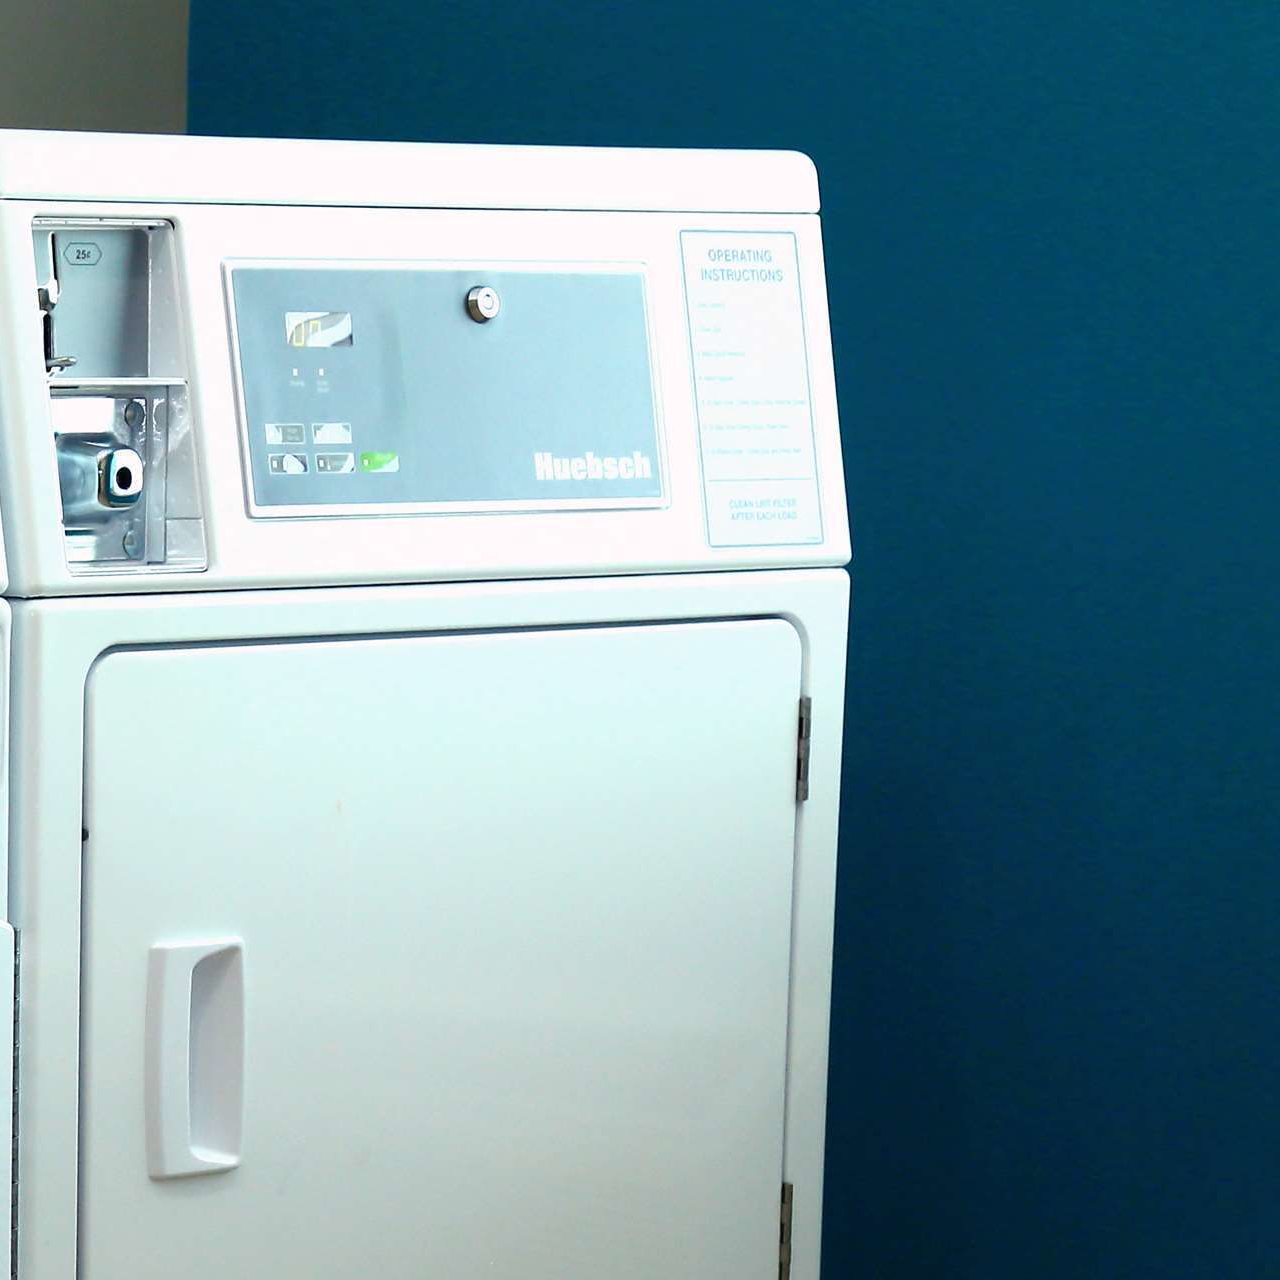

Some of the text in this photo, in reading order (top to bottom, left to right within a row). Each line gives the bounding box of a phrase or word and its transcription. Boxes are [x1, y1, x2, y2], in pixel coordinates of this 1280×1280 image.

[708, 250, 772, 262] OPERATING
[701, 268, 783, 281] INSTRUCTIONS
[534, 452, 651, 480] Huebsch
